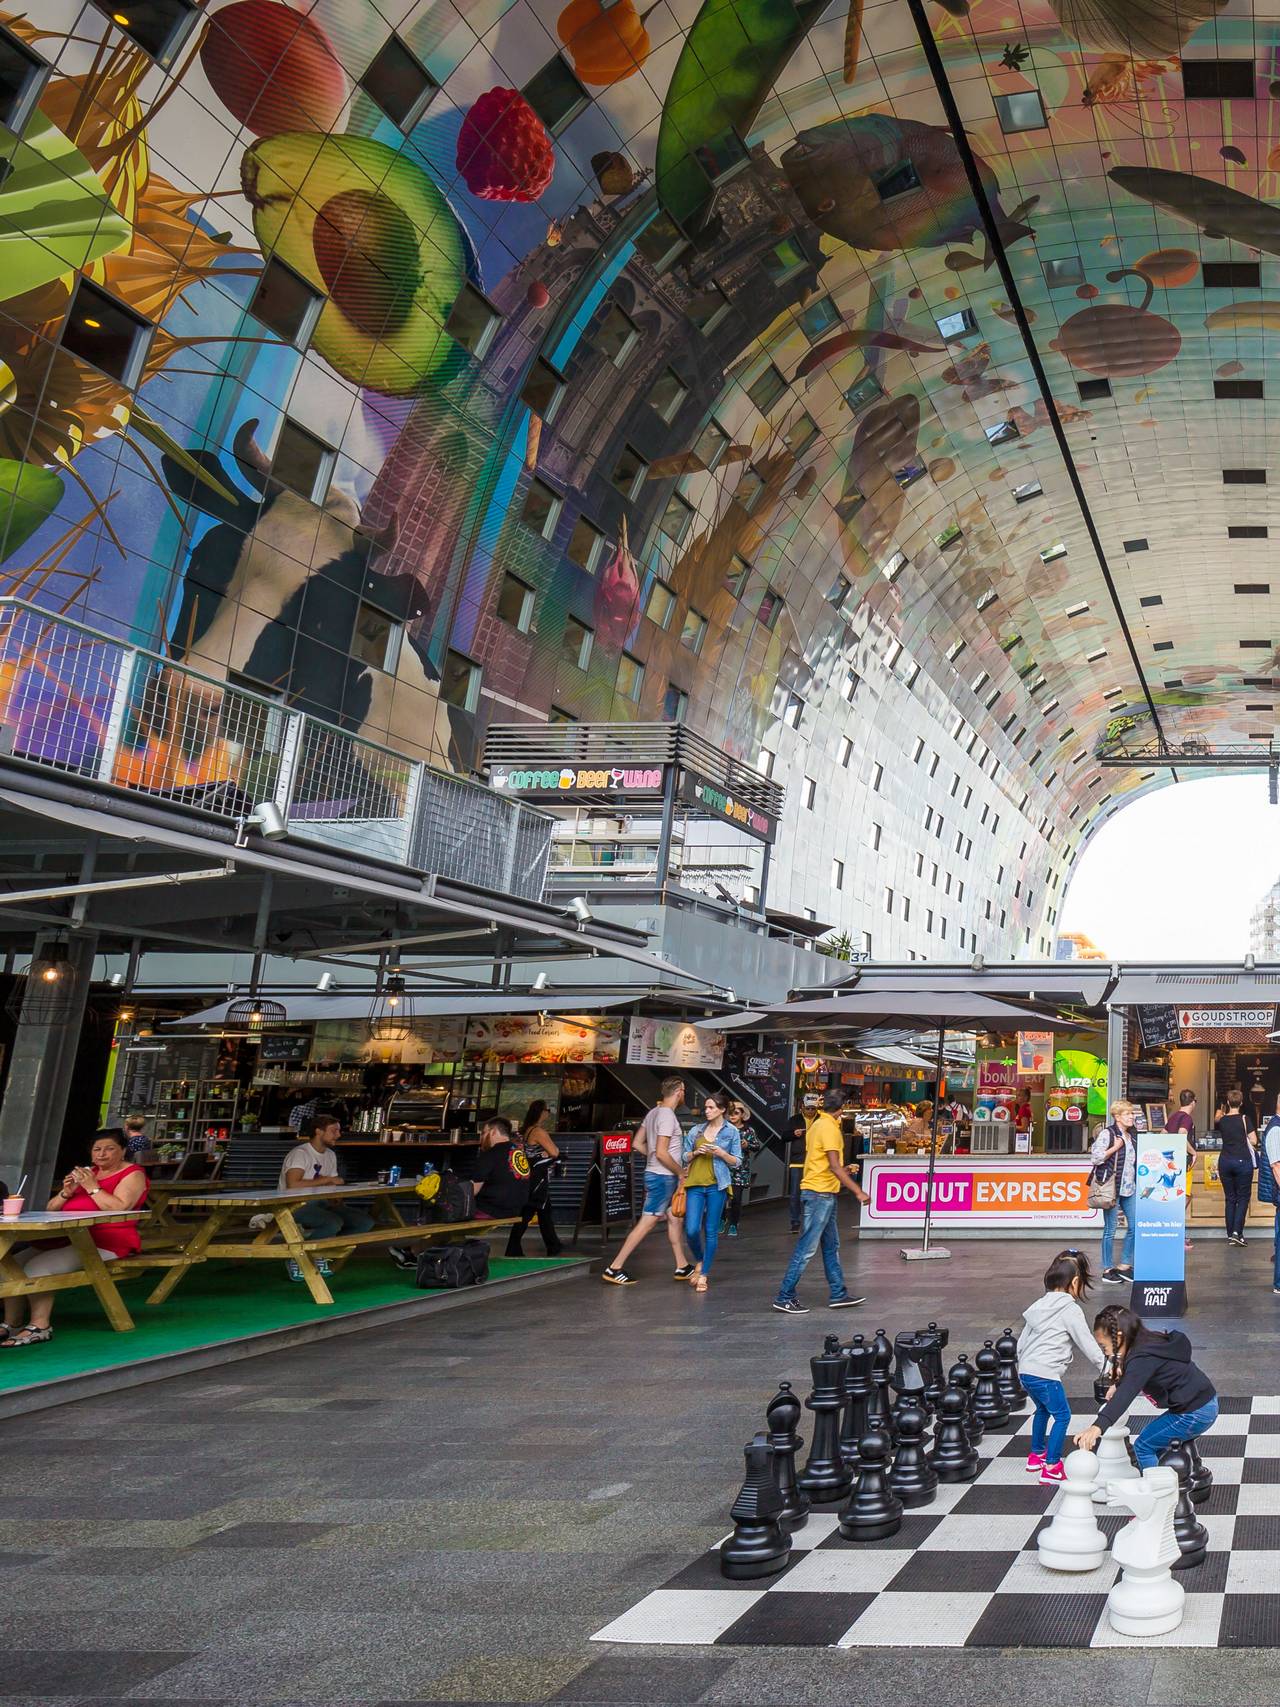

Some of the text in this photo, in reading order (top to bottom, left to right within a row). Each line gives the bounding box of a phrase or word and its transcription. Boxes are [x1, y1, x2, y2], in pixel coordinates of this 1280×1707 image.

[851, 952, 868, 962] 37
[1192, 1011, 1273, 1021] GOUDSTROOP
[1058, 1074, 1107, 1088] fuzete
[886, 1181, 1081, 1203] DONUT EXPRESS
